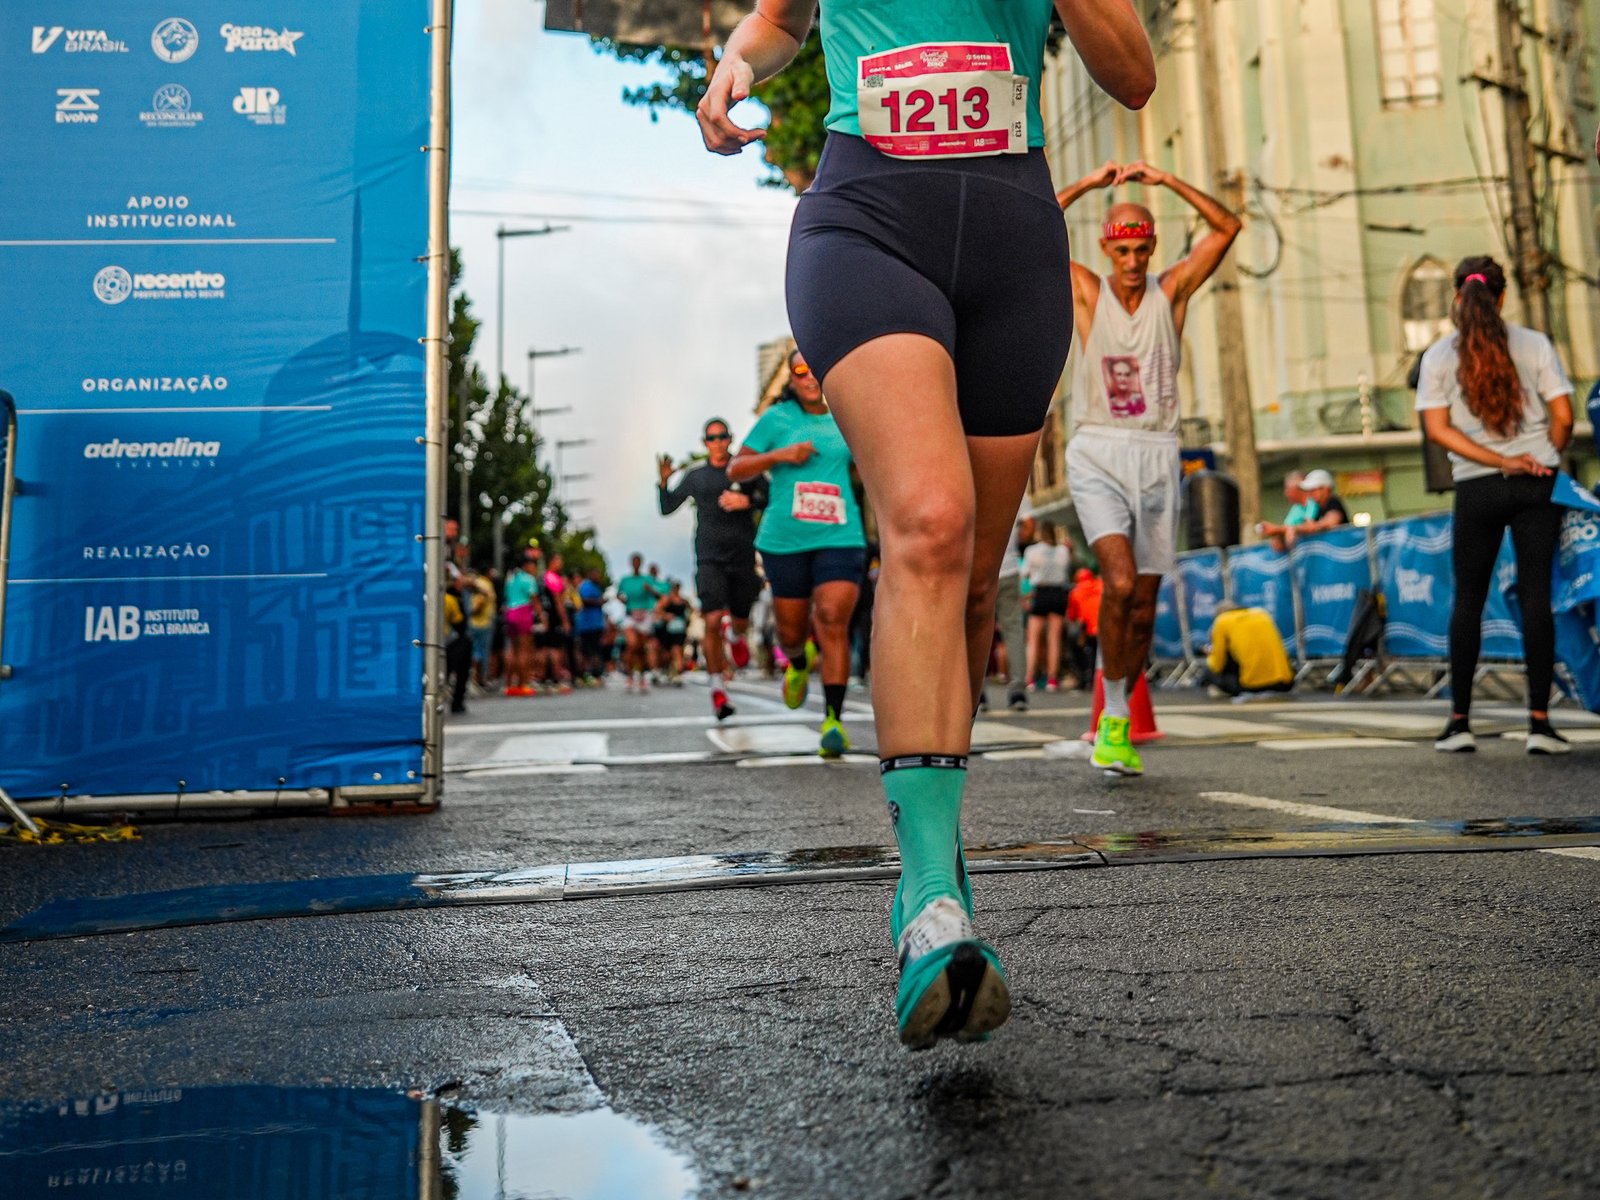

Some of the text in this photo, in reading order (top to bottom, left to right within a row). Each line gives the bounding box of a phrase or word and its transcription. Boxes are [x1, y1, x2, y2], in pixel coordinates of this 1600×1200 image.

[65, 30, 109, 41] VITA
[64, 40, 130, 53] BRASIL
[1015, 84, 1023, 100] 1213
[55, 111, 99, 124] Evolve
[880, 86, 990, 133] 1213
[1014, 121, 1022, 138] 1213
[126, 196, 190, 210] APOIO
[86, 214, 237, 228] INSTITUCIONAL
[133, 270, 226, 290] recentro
[81, 375, 229, 394] ORGANIZAÇÃO
[84, 437, 221, 459] adrenalina
[82, 543, 211, 561] REALIZAÇÃO
[143, 608, 200, 622] INSTITUTO
[84, 605, 141, 642] IAB
[143, 622, 211, 636] ASA BRANCA
